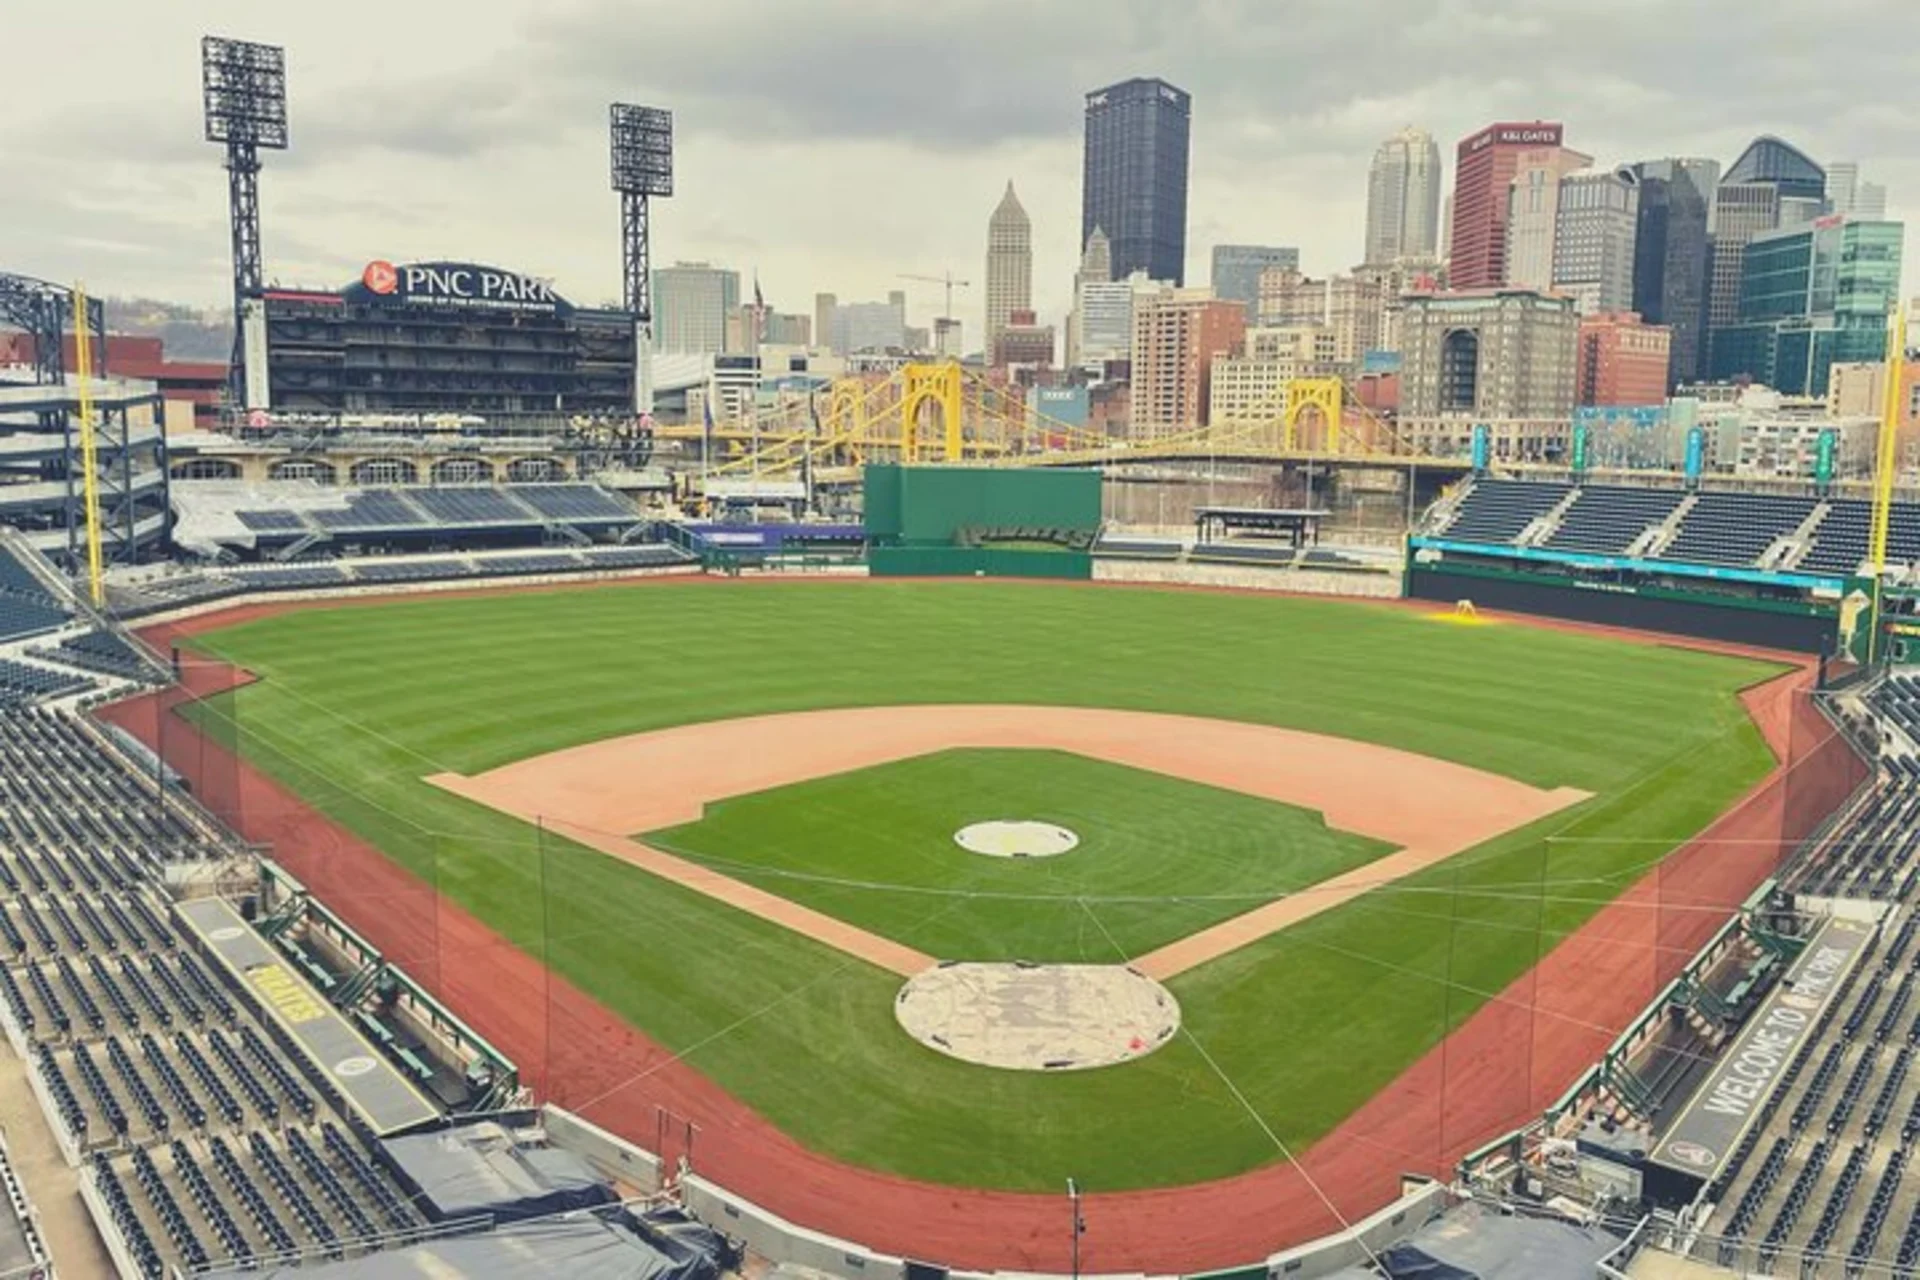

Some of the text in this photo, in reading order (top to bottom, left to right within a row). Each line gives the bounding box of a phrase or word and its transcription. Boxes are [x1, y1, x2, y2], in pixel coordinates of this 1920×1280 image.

[406, 268, 557, 302] PNC PARK
[1703, 1028, 1794, 1116] WELCOME
[1764, 1007, 1807, 1031] TO
